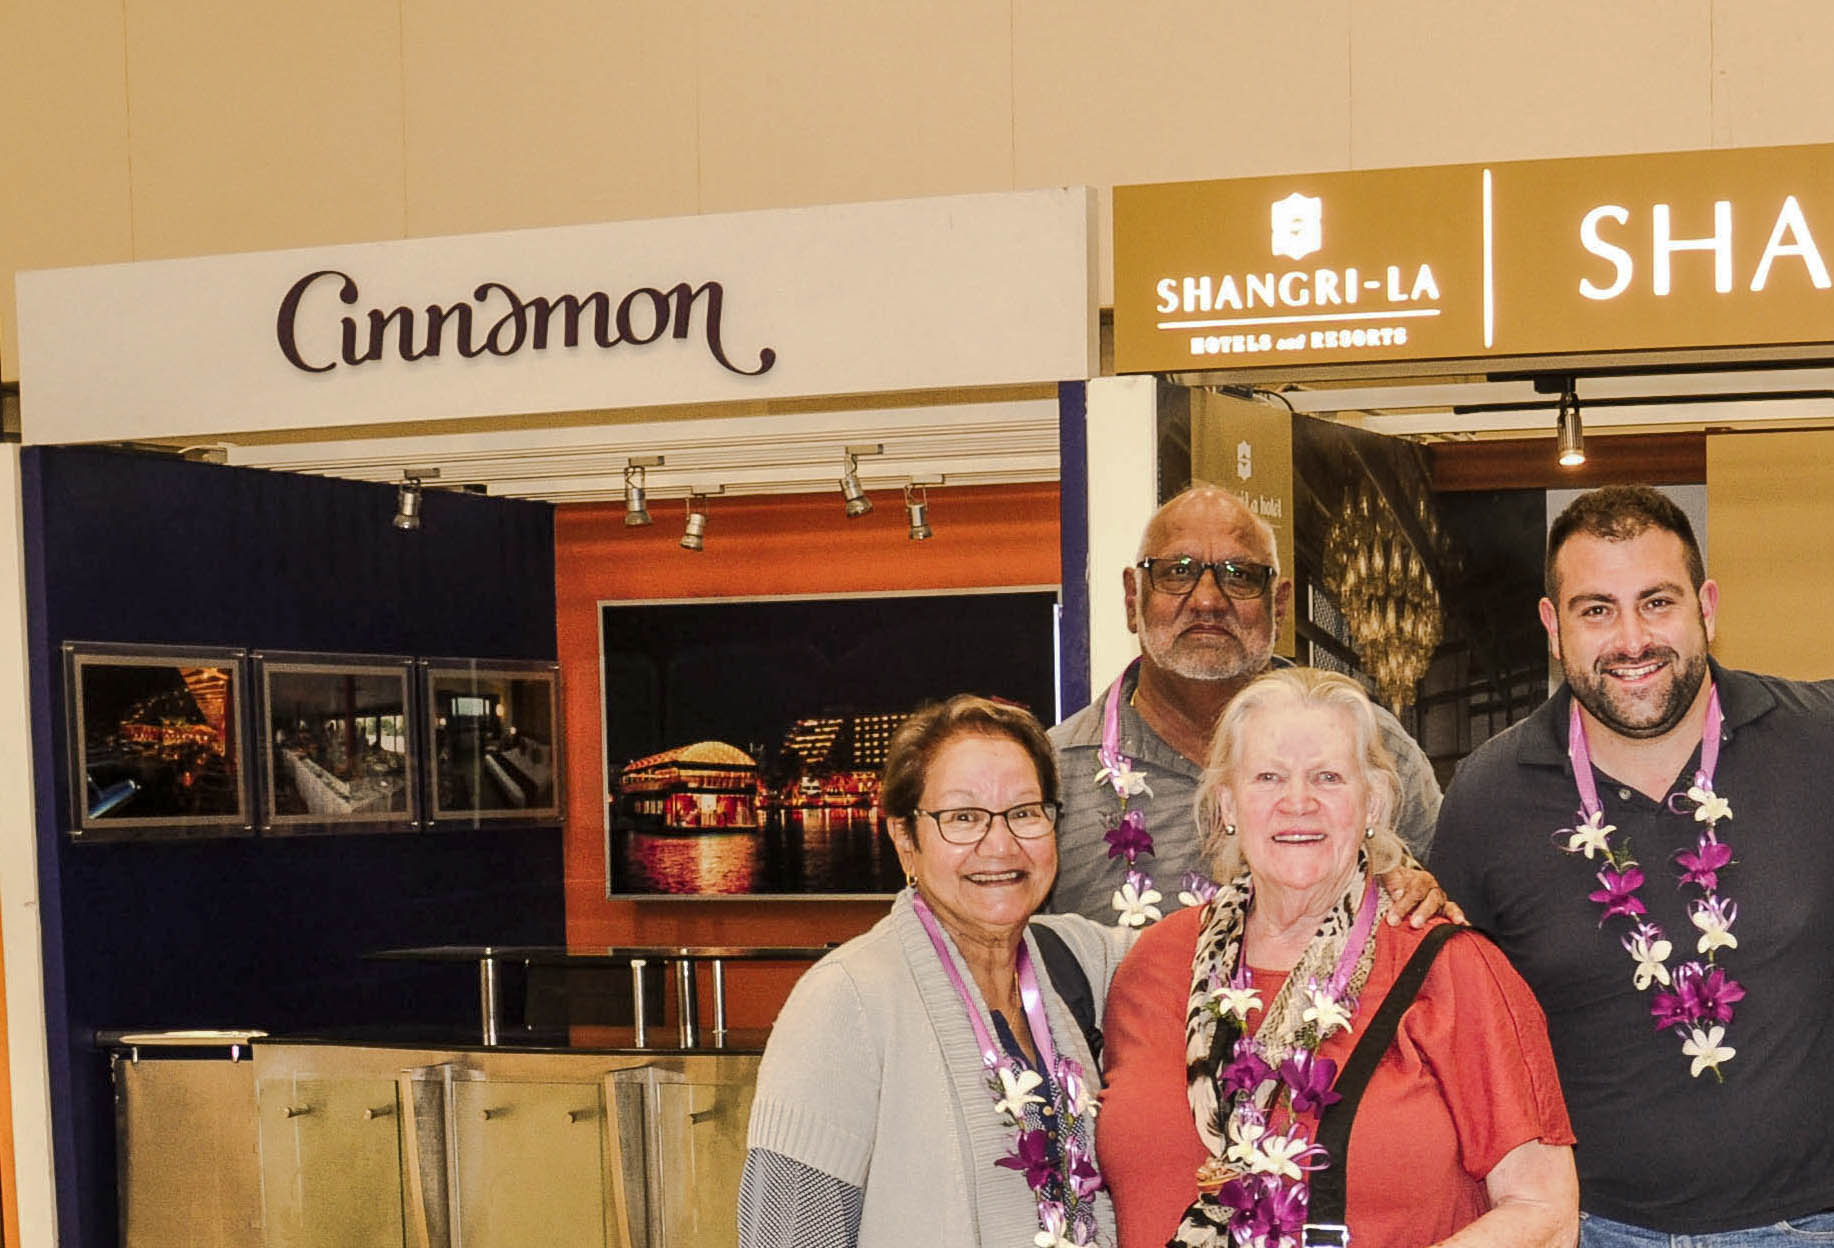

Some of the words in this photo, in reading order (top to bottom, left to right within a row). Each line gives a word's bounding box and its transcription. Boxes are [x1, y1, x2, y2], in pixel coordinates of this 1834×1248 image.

[1156, 264, 1440, 313] SHANGRI-LA
[276, 270, 777, 376] Cinnamon
[1190, 334, 1272, 355] HOTELS
[1310, 327, 1408, 349] RESORTS
